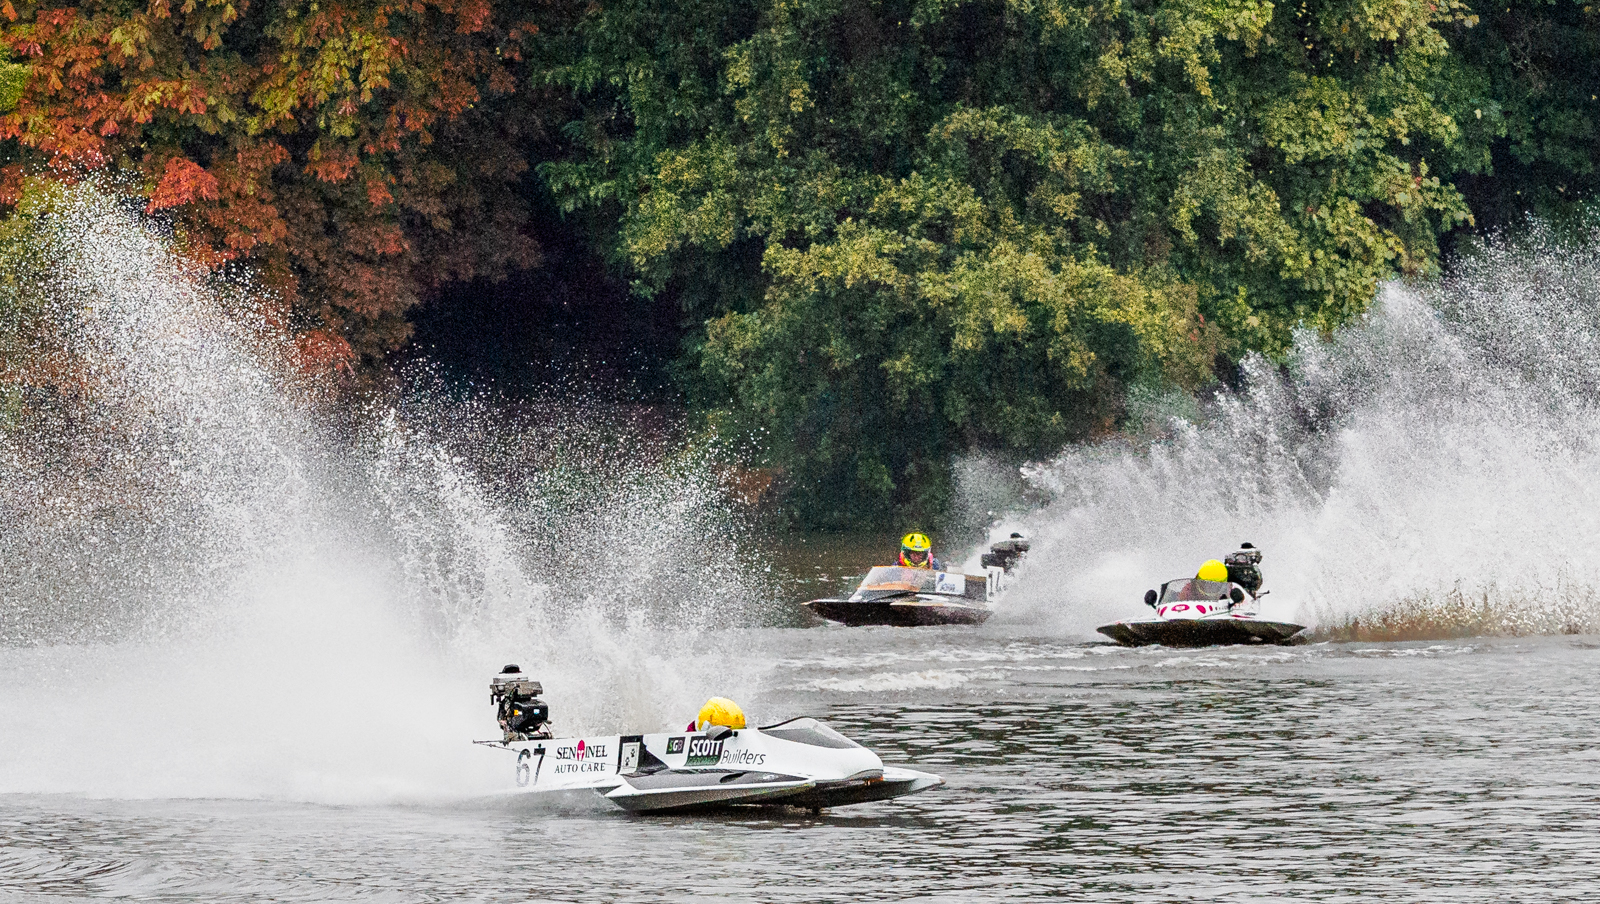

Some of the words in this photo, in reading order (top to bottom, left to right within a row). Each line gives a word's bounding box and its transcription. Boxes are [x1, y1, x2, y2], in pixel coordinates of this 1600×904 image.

[669, 739, 683, 751] SGB
[690, 739, 722, 756] SCOTT
[721, 749, 766, 765] Builders
[516, 747, 546, 787] 67
[554, 764, 578, 774] AUTO
[580, 762, 606, 772] CARE
